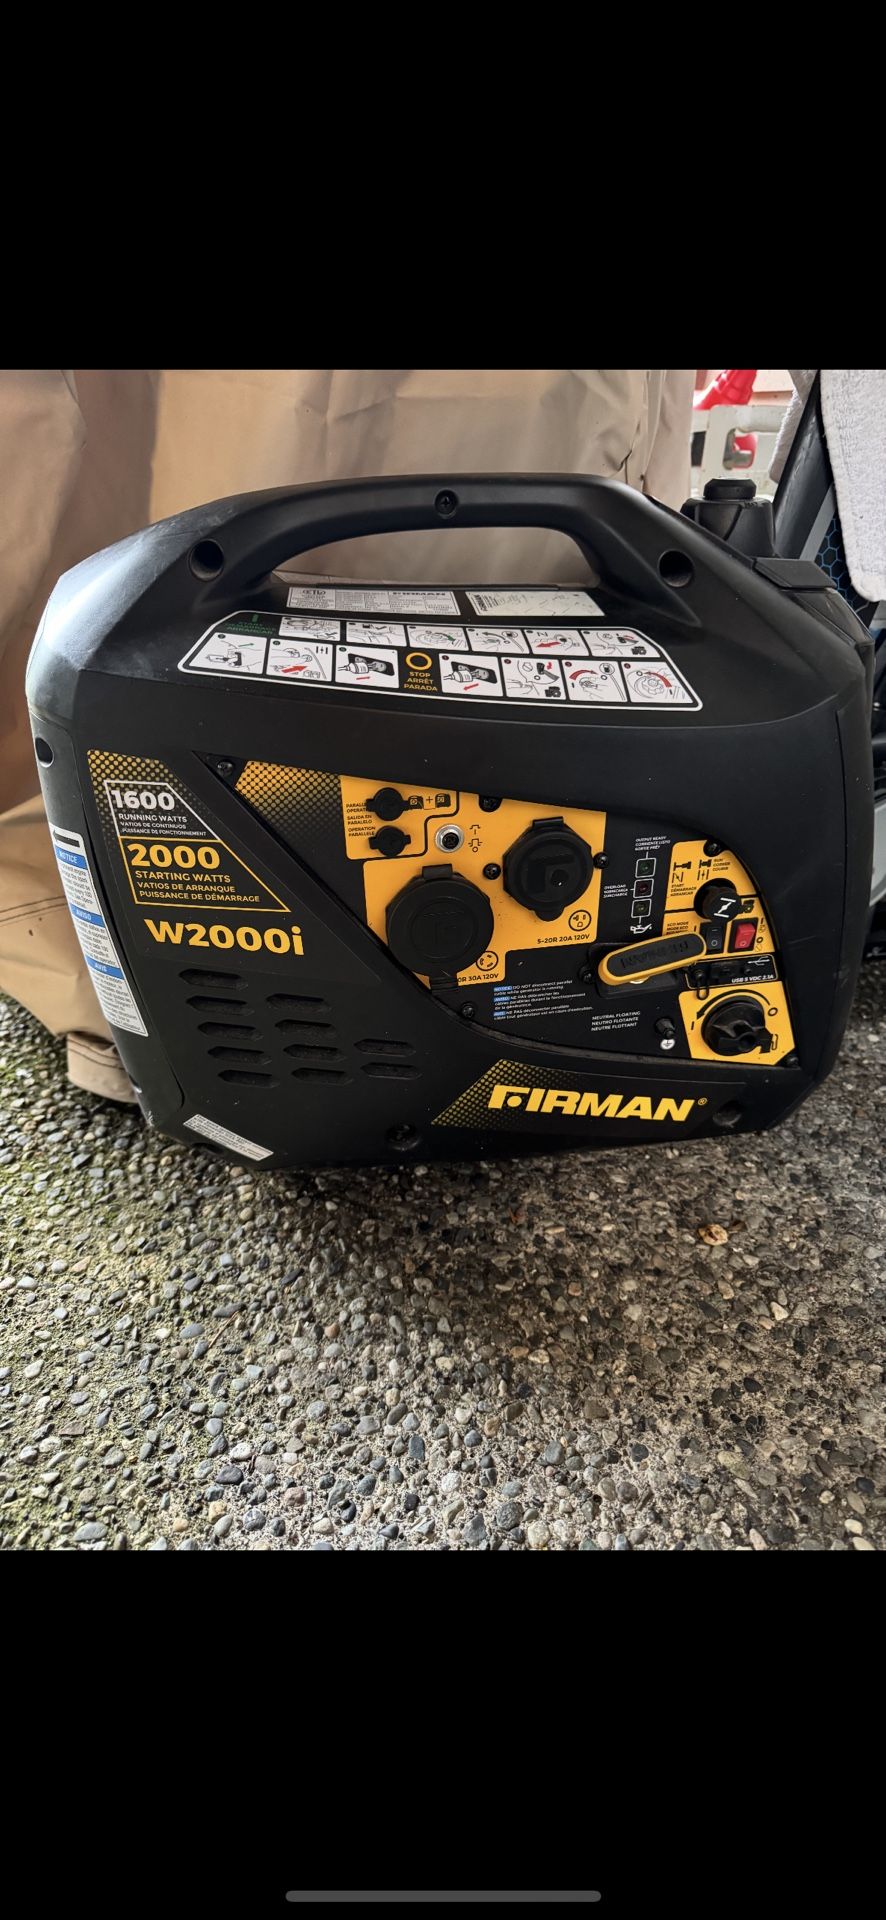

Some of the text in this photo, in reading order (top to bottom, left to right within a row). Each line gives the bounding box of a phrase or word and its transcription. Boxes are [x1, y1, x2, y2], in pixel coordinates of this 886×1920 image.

[404, 684, 438, 692] PARADA
[111, 789, 175, 811] 1600
[118, 813, 188, 823] RUNNING WATTS
[127, 843, 220, 870] 2000
[135, 870, 230, 883] STARTING WATTS
[136, 881, 170, 890] VATIOS
[185, 884, 236, 894] ARRANQUE
[140, 890, 190, 900] PUISSANCE
[204, 892, 260, 902] DÉMARRAGE
[144, 918, 304, 956] W2000i
[537, 936, 558, 945] 5-20R
[488, 1084, 695, 1122] FIRMAN
